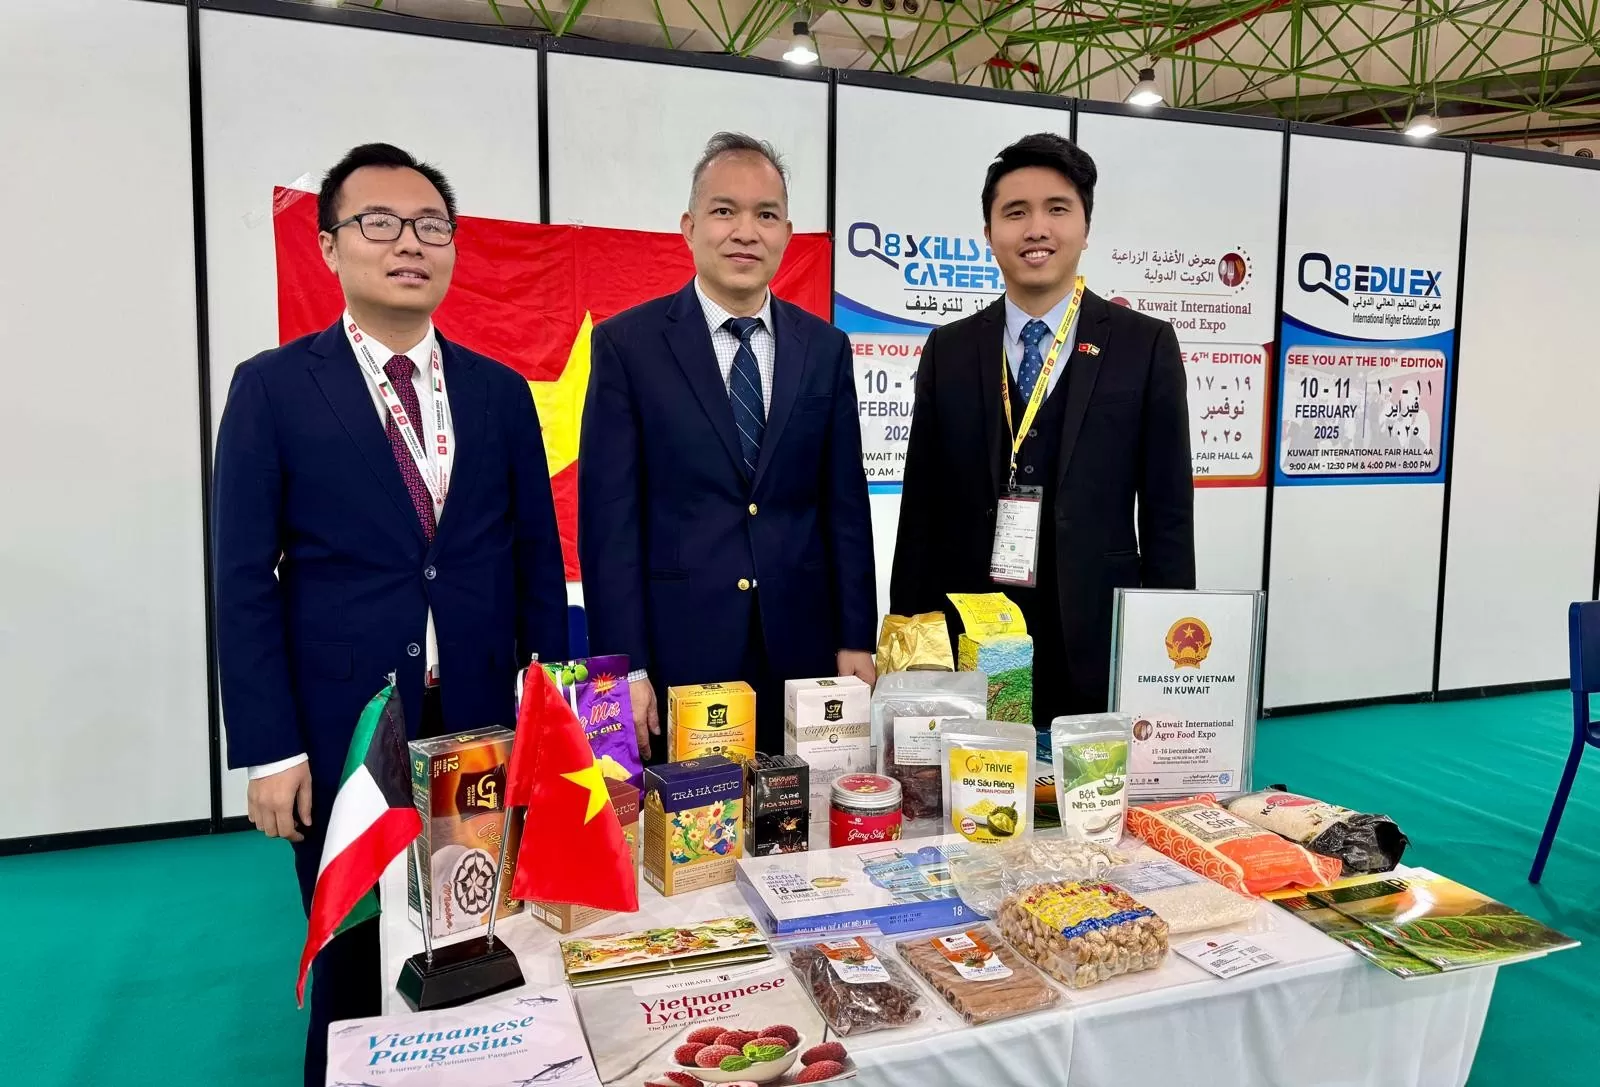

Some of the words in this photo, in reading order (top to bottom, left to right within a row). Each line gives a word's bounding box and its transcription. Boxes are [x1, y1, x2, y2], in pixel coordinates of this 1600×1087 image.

[1111, 248, 1148, 265] الزراعية
[1151, 249, 1185, 266] الأغذية
[1188, 254, 1216, 267] معرض
[904, 262, 1005, 289] CAREER
[1144, 268, 1177, 283] الدولية
[1180, 271, 1214, 285] الكويت
[1137, 299, 1177, 312] Kuwait
[1180, 300, 1252, 314] International
[1352, 296, 1374, 310] الدولي
[1375, 297, 1395, 311] العالي
[1396, 298, 1417, 311] التعليم
[1418, 300, 1442, 312] معرض
[1170, 317, 1196, 330] Food
[1199, 319, 1226, 334] Expo
[1352, 312, 1385, 324] International
[1385, 313, 1402, 327] Higher
[1402, 314, 1427, 326] Education
[1427, 316, 1441, 329] Expo
[878, 344, 909, 357] YOU
[1212, 353, 1262, 365] EDITION
[1287, 354, 1309, 365] SEE
[1312, 355, 1336, 366] YOU
[1337, 356, 1353, 366] AT
[1356, 356, 1377, 367] THE
[1400, 357, 1443, 368] EDITION
[864, 370, 888, 394] 10
[1300, 377, 1319, 399] 10
[1335, 377, 1350, 399] 11
[1200, 397, 1245, 420] نوفمبر
[1295, 404, 1357, 419] FEBRUARY
[1385, 396, 1419, 418] فبراير
[884, 426, 909, 441] 202
[1201, 428, 1242, 444] ٢٠٢٥
[1313, 425, 1340, 439] 2025
[1387, 425, 1419, 438] ٢٠٢٥
[1196, 452, 1216, 460] FAIR
[1218, 452, 1240, 460] HALL
[1241, 451, 1253, 460] 4A
[1287, 449, 1319, 457] KUWAIT
[1321, 449, 1383, 457] INTERNATIONAL
[1384, 449, 1401, 457] FAIR
[878, 468, 894, 476] AM
[1196, 466, 1209, 474] PM
[1289, 462, 1306, 470] 9:00
[1307, 462, 1320, 470] AM
[1327, 462, 1345, 470] 12:30
[1347, 462, 1359, 470] PM
[1360, 462, 1366, 470] &
[1367, 461, 1384, 469] 4:00
[1385, 461, 1397, 469] PM
[1402, 461, 1419, 469] 8:00
[1420, 461, 1431, 469] PM
[1137, 675, 1180, 683] EMBASSY
[1182, 675, 1194, 683] OF
[1196, 675, 1236, 683] VIETNAM
[1163, 687, 1173, 695] IN
[1174, 686, 1211, 695] KUWAIT
[709, 708, 726, 719] G7
[1156, 720, 1183, 729] Kuwait
[1185, 719, 1234, 728] International
[1155, 731, 1175, 741] Agro
[1177, 730, 1196, 739] Food
[1197, 731, 1217, 740] Expo
[447, 754, 459, 772] 12
[985, 763, 1013, 773] TRIVIE
[477, 774, 497, 809] G7
[1079, 789, 1095, 801] Bột
[1072, 801, 1096, 809] Nha
[1100, 798, 1121, 808] Đam
[770, 886, 789, 895] 18
[952, 905, 963, 916] 18
[666, 982, 684, 990] VIET
[684, 978, 712, 987] BRAND
[640, 977, 786, 1013] Vietnamese
[645, 1002, 732, 1025] Lychee
[368, 1015, 535, 1050] Vietnamese
[366, 1033, 524, 1068] Pangasius
[389, 1064, 422, 1074] Journey
[424, 1061, 435, 1069] of
[436, 1056, 486, 1067] Vietnamese
[487, 1048, 529, 1060] Pangasius
